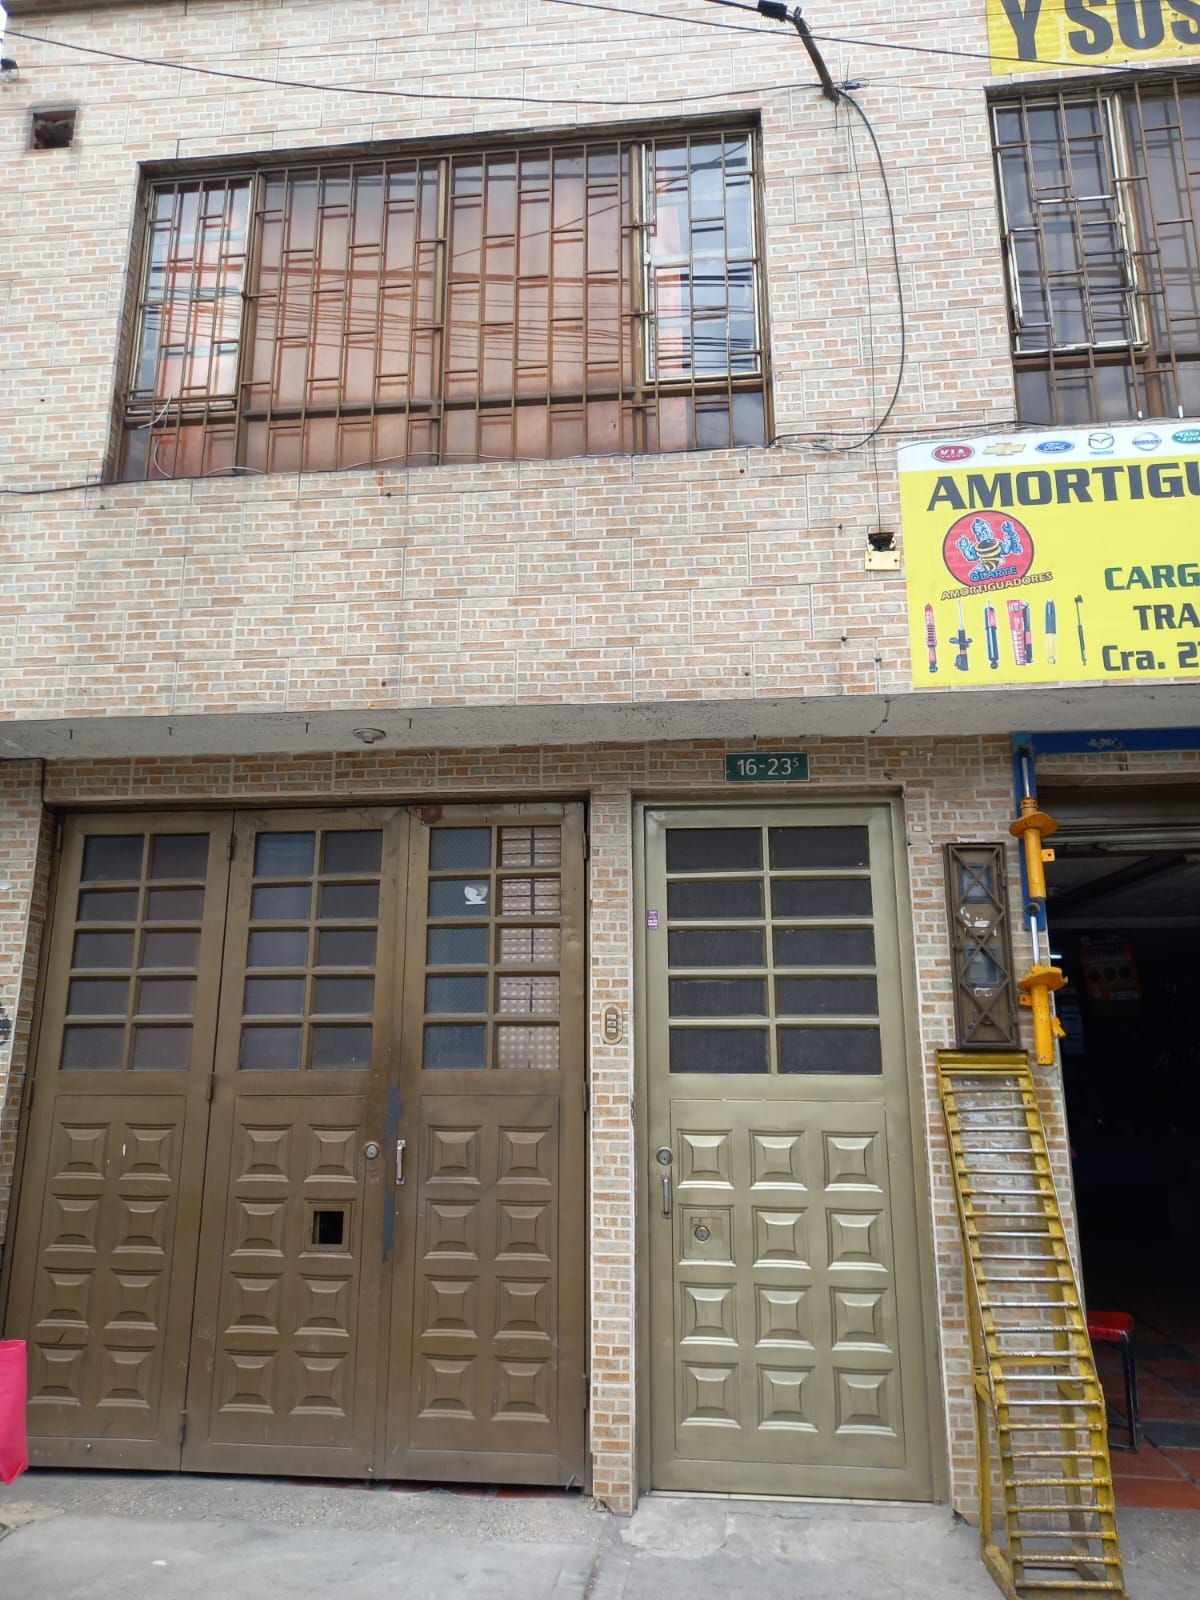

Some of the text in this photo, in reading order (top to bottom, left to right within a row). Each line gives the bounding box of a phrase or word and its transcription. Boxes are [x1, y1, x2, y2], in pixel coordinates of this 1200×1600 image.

[1131, 438, 1162, 446] NISSAN
[940, 571, 1054, 601] AMORTIGUADORES
[969, 566, 1018, 582] OLARTE
[1104, 563, 1200, 591] CARG
[1133, 602, 1200, 630] TRA
[1102, 641, 1200, 671] Cra. 2
